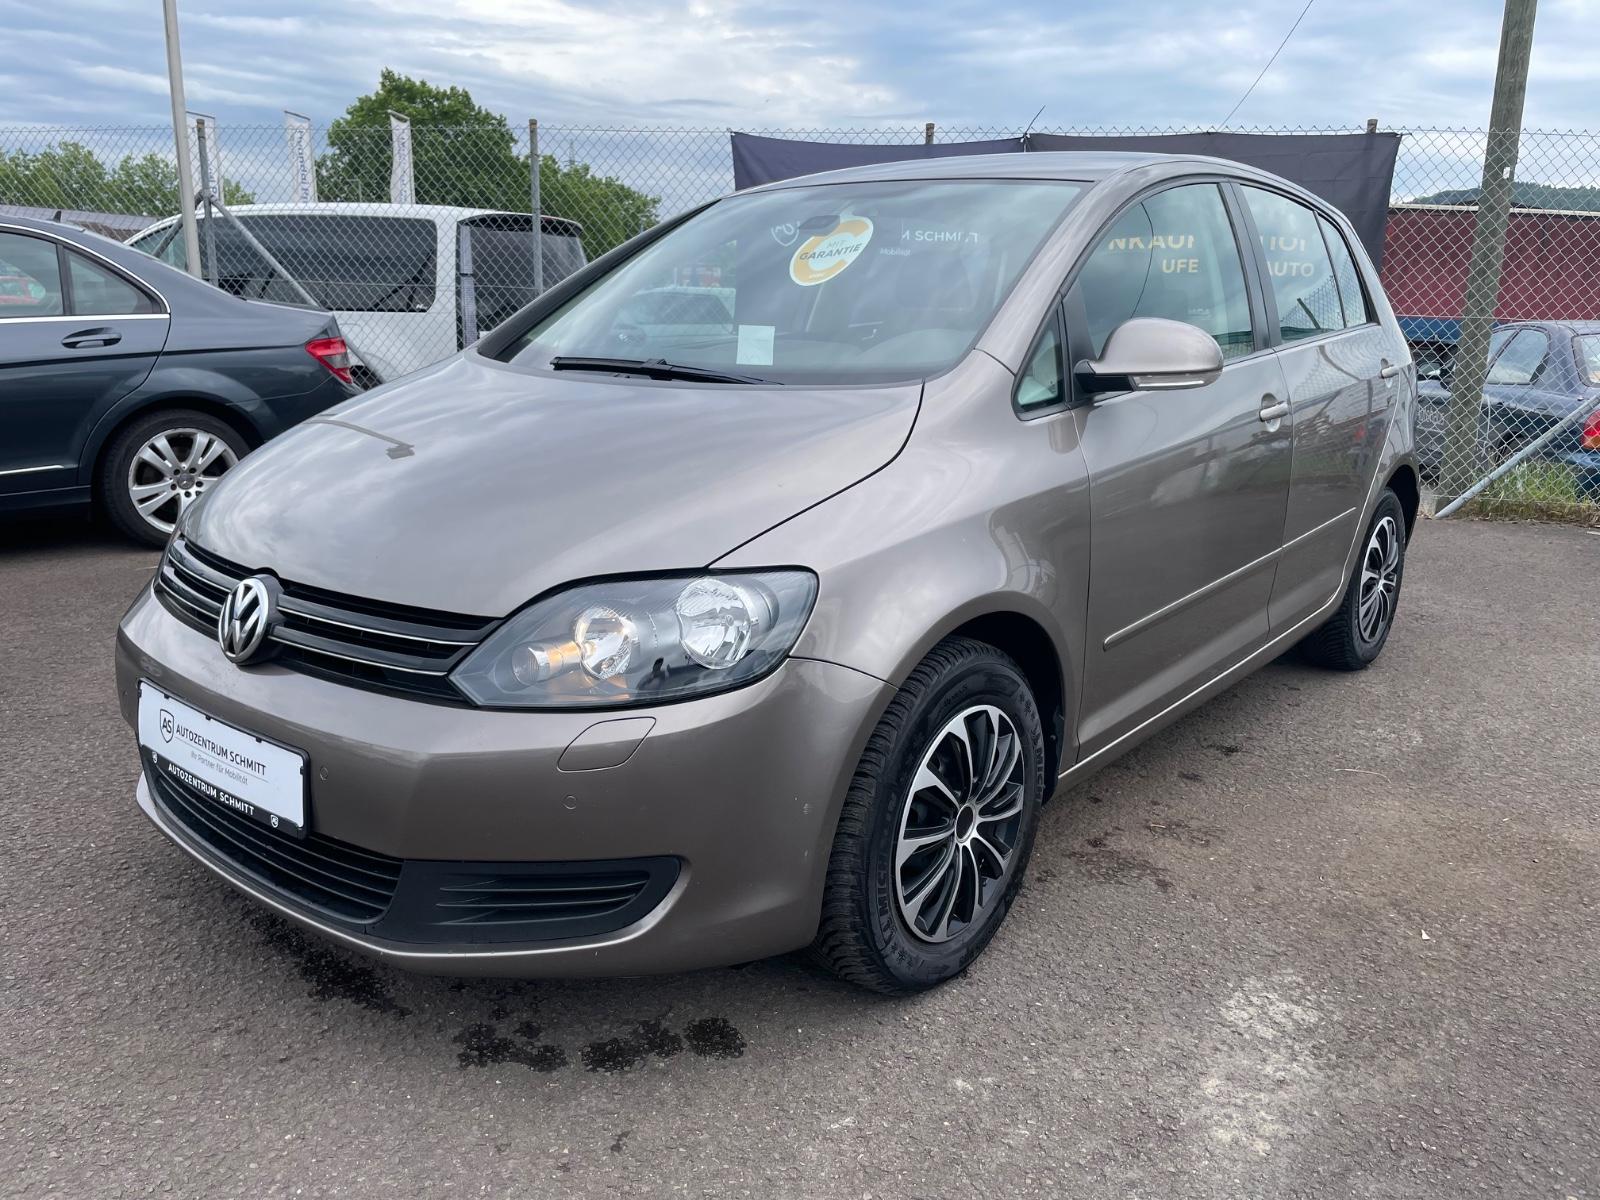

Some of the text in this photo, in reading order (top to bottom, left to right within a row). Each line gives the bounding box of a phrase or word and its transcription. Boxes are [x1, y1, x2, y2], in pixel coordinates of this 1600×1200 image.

[800, 243, 862, 260] GARANTIE
[162, 717, 172, 734] AS
[176, 724, 228, 759] AUTOZENTRUM
[229, 751, 266, 774] SCHMITT
[168, 763, 254, 815] AUTOZENTRUM SCHMITT
